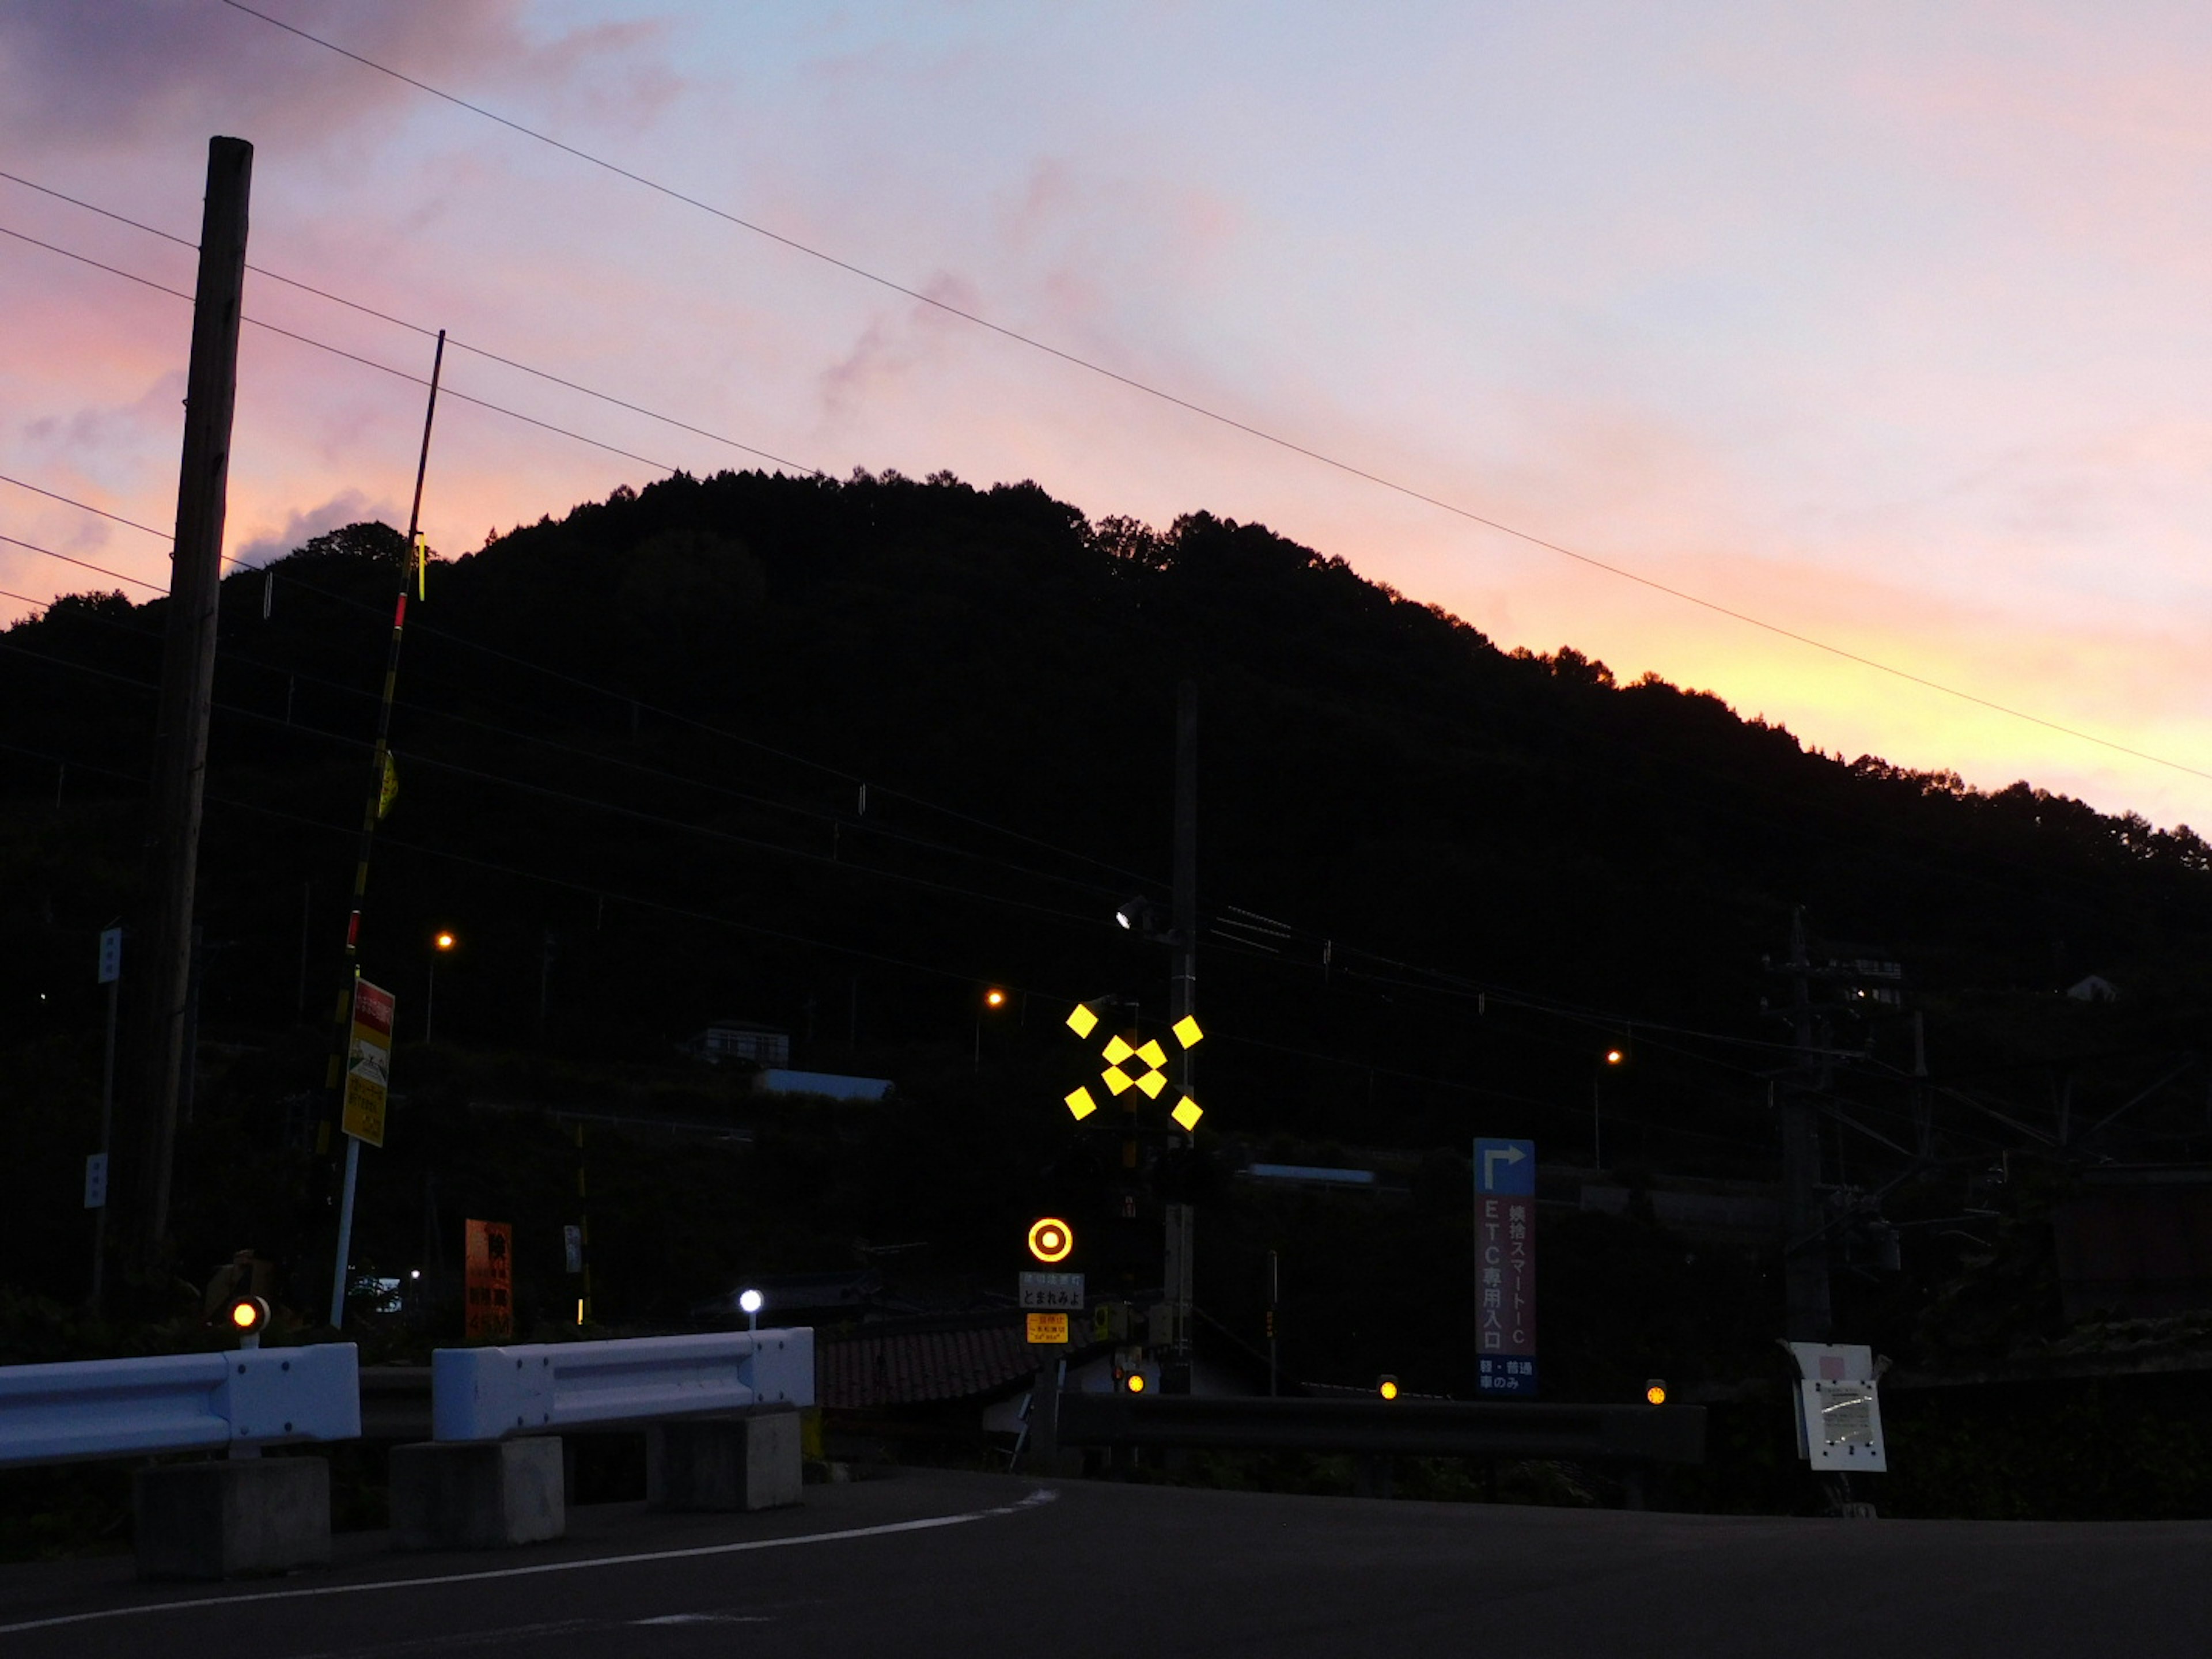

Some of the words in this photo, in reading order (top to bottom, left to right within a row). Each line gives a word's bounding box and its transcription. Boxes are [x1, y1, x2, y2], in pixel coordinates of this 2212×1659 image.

[1483, 1200, 1502, 1349] ETC専用入口
[1024, 1290, 1079, 1305] とまれみよ
[1479, 1360, 1533, 1376] 軽・普通
[1479, 1375, 1520, 1389] 車のみ
